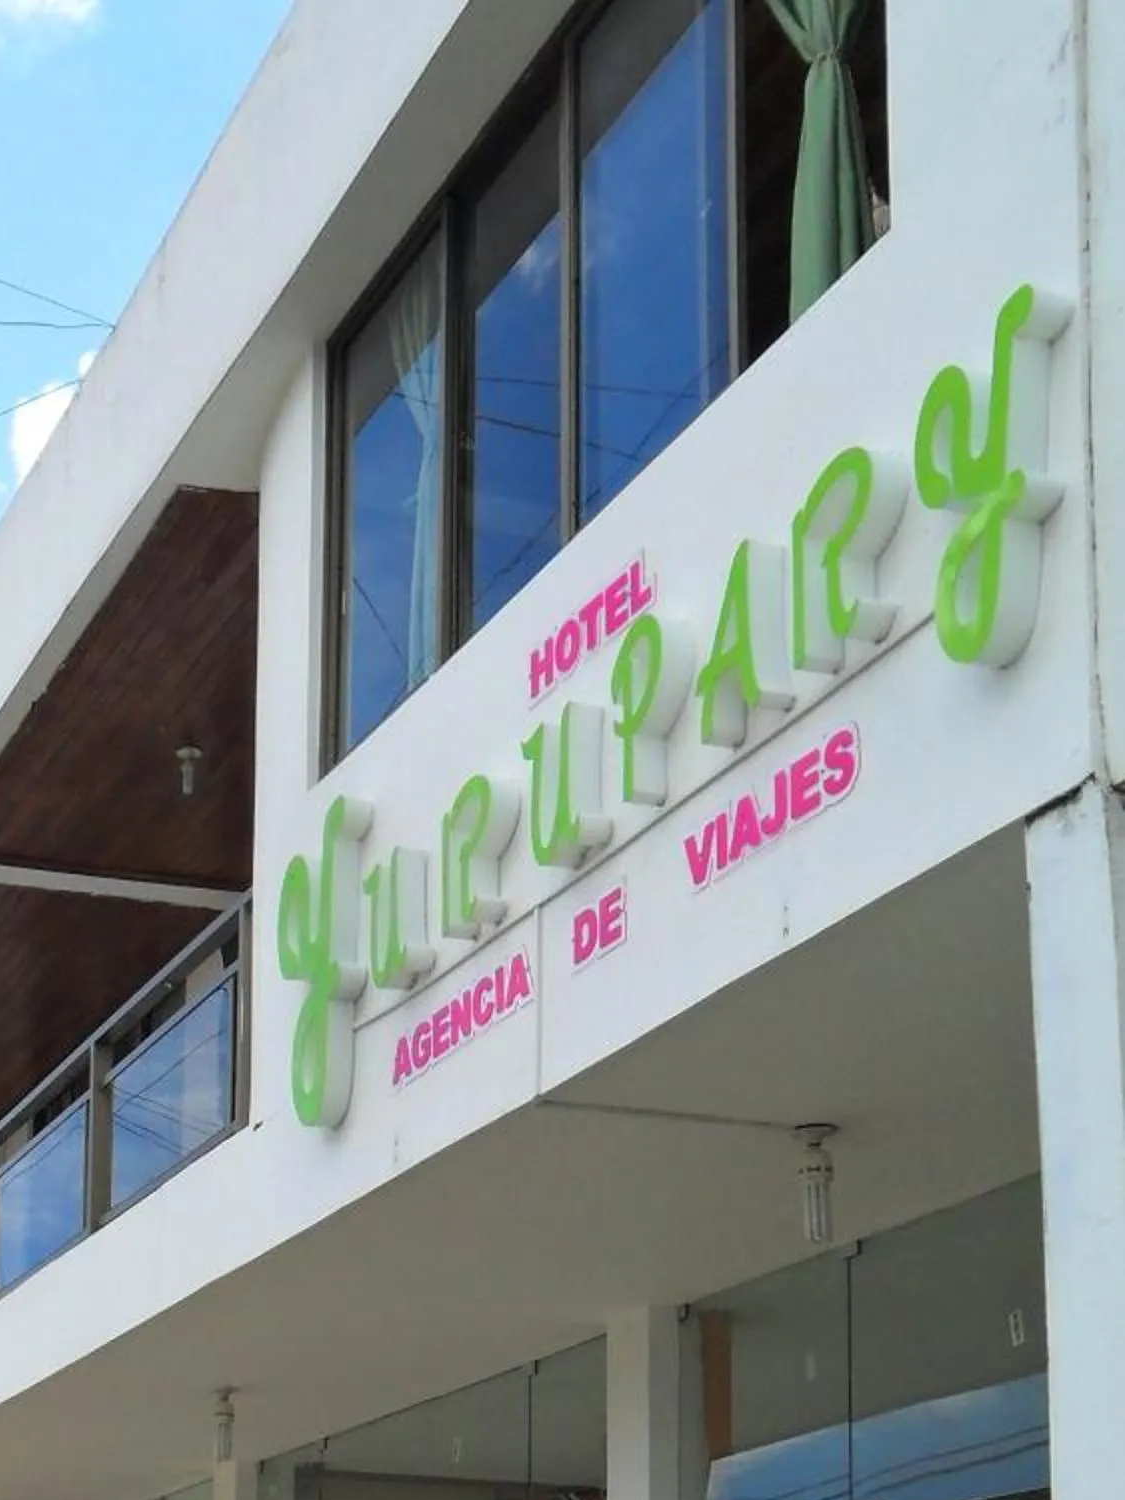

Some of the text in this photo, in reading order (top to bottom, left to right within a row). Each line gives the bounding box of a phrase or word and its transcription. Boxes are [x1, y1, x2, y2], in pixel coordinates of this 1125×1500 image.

[529, 561, 653, 697] HOTEL
[393, 728, 857, 1082] AGENCIA DE VIAJES
